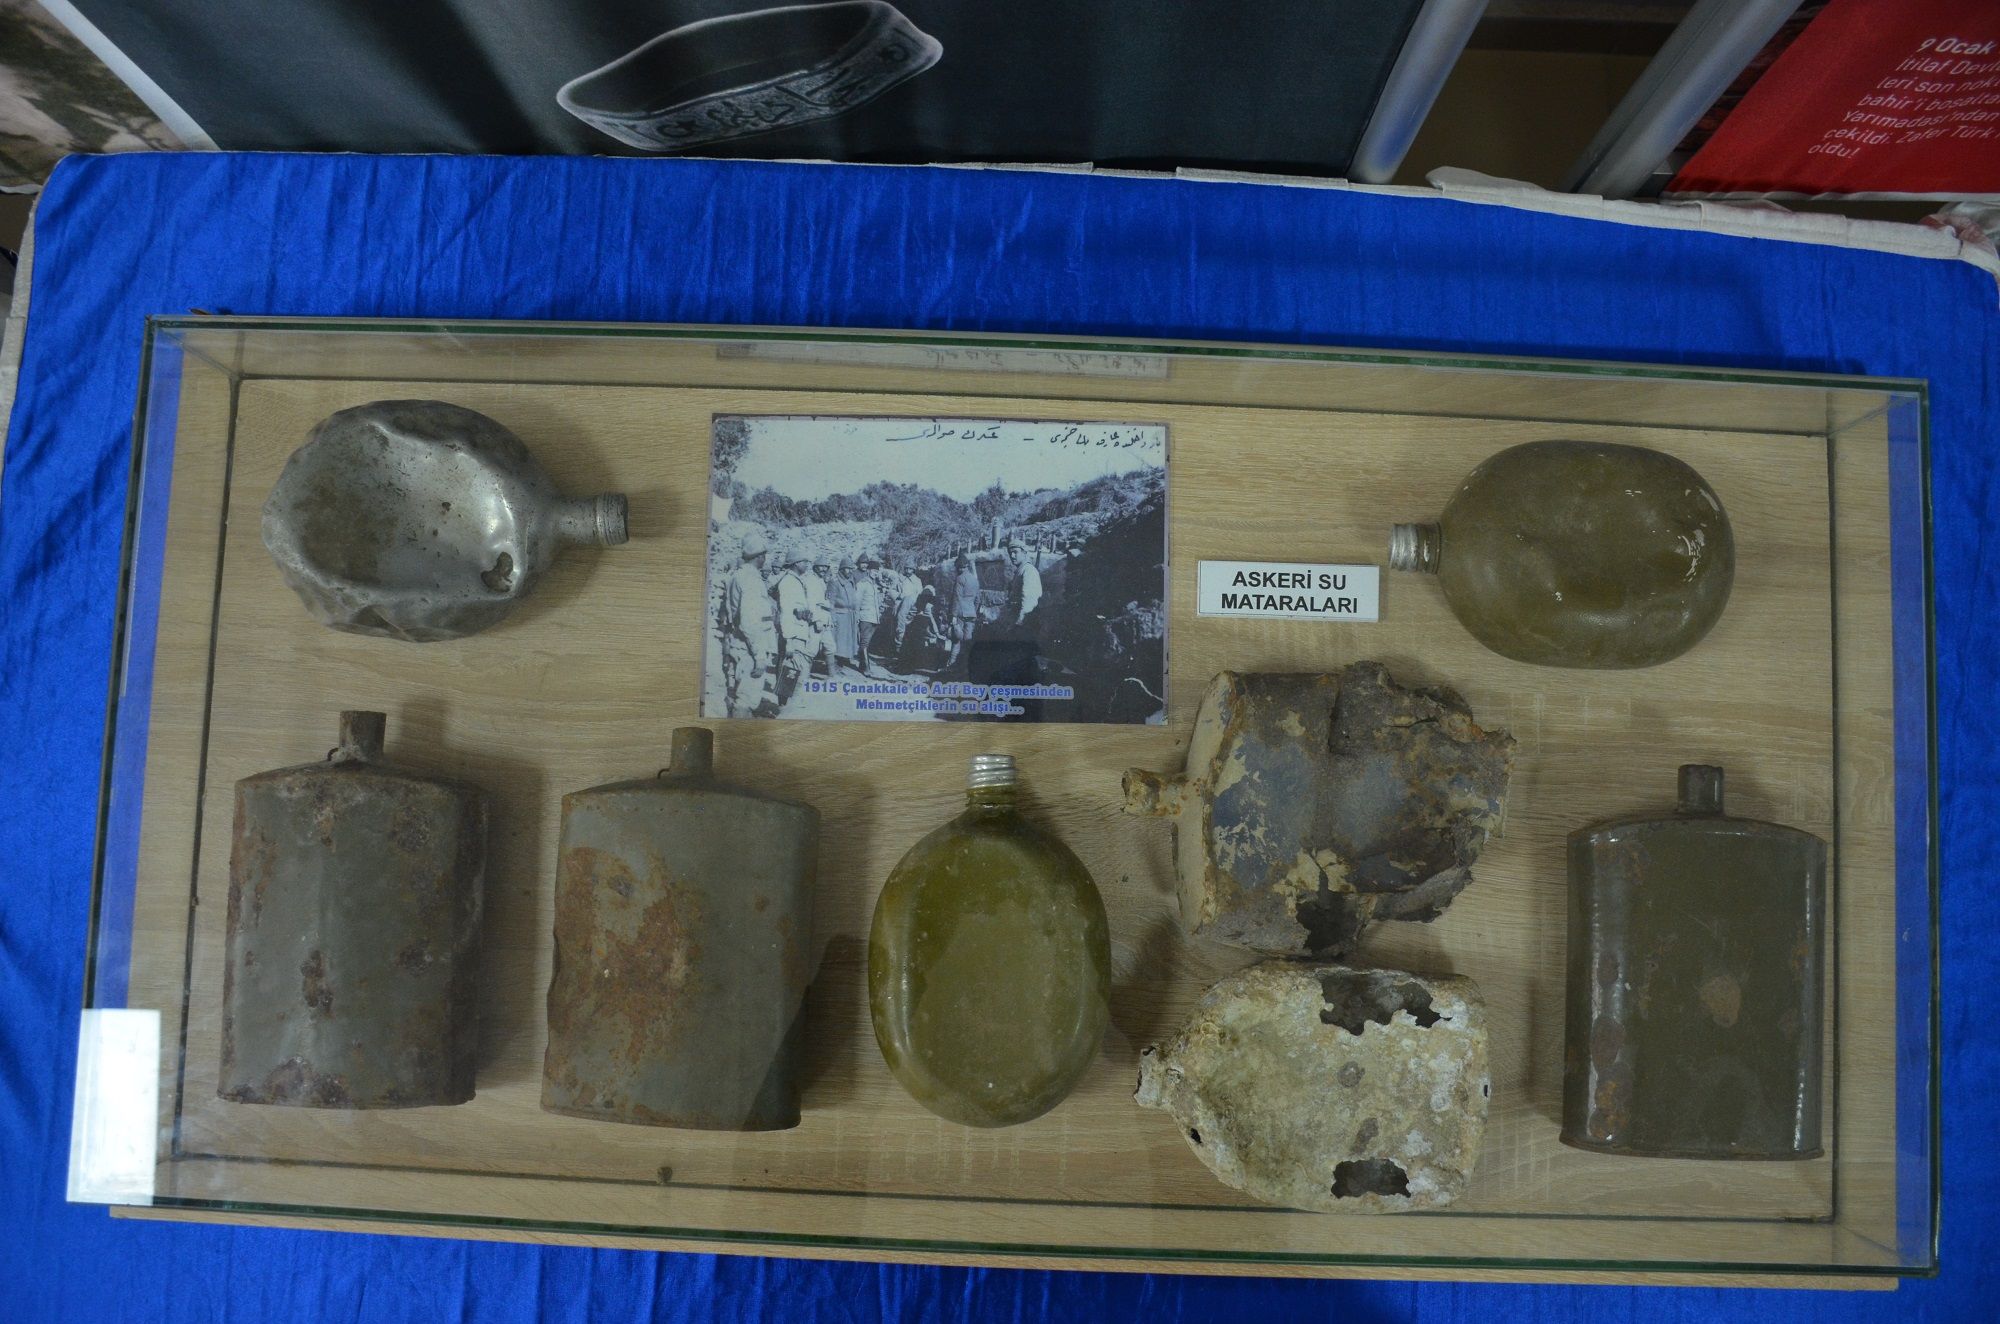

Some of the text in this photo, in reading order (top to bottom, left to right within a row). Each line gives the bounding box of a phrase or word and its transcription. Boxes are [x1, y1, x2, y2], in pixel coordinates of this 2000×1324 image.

[1916, 38, 1996, 55] 9 Ocak
[1876, 76, 1919, 90] leri
[1914, 81, 1955, 94] son
[1895, 127, 1950, 144] Zafer
[1950, 125, 1993, 139] Türk
[1807, 142, 1861, 159] oldu!
[1232, 569, 1346, 591] ASKERİ SU
[1221, 593, 1358, 614] MATARALARI
[803, 682, 838, 694] 1915
[932, 682, 959, 696] Arif
[962, 684, 986, 698] Bey
[990, 684, 1072, 700] çeşmesinden
[856, 698, 1024, 716] Mehmetçiklerin su alışı...
